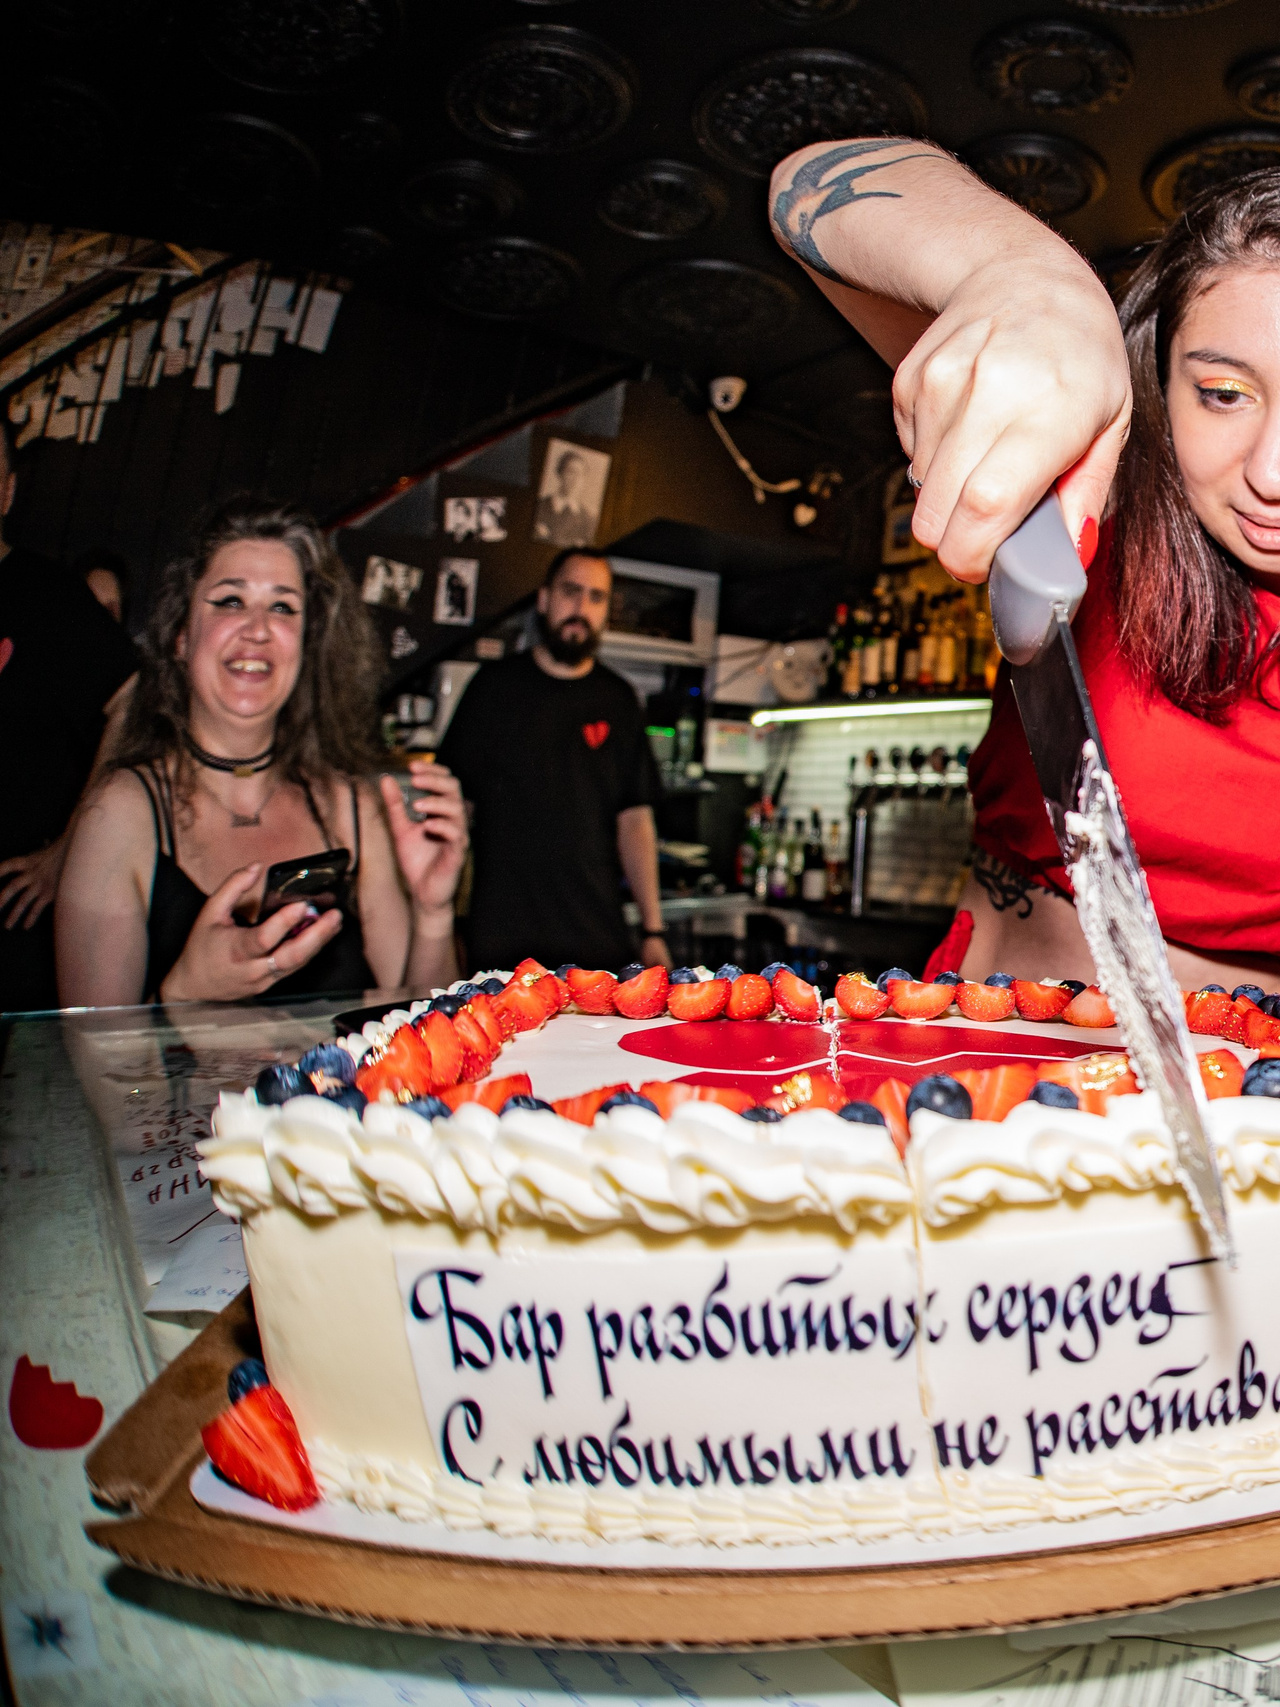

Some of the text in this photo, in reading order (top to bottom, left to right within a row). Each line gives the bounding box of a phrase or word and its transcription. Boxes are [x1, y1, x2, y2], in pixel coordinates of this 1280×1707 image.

[409, 1257, 1218, 1400] Бар разбитых сердец
[441, 1397, 505, 1487] С
[522, 1400, 916, 1489] любимыми
[932, 1414, 1009, 1470] не
